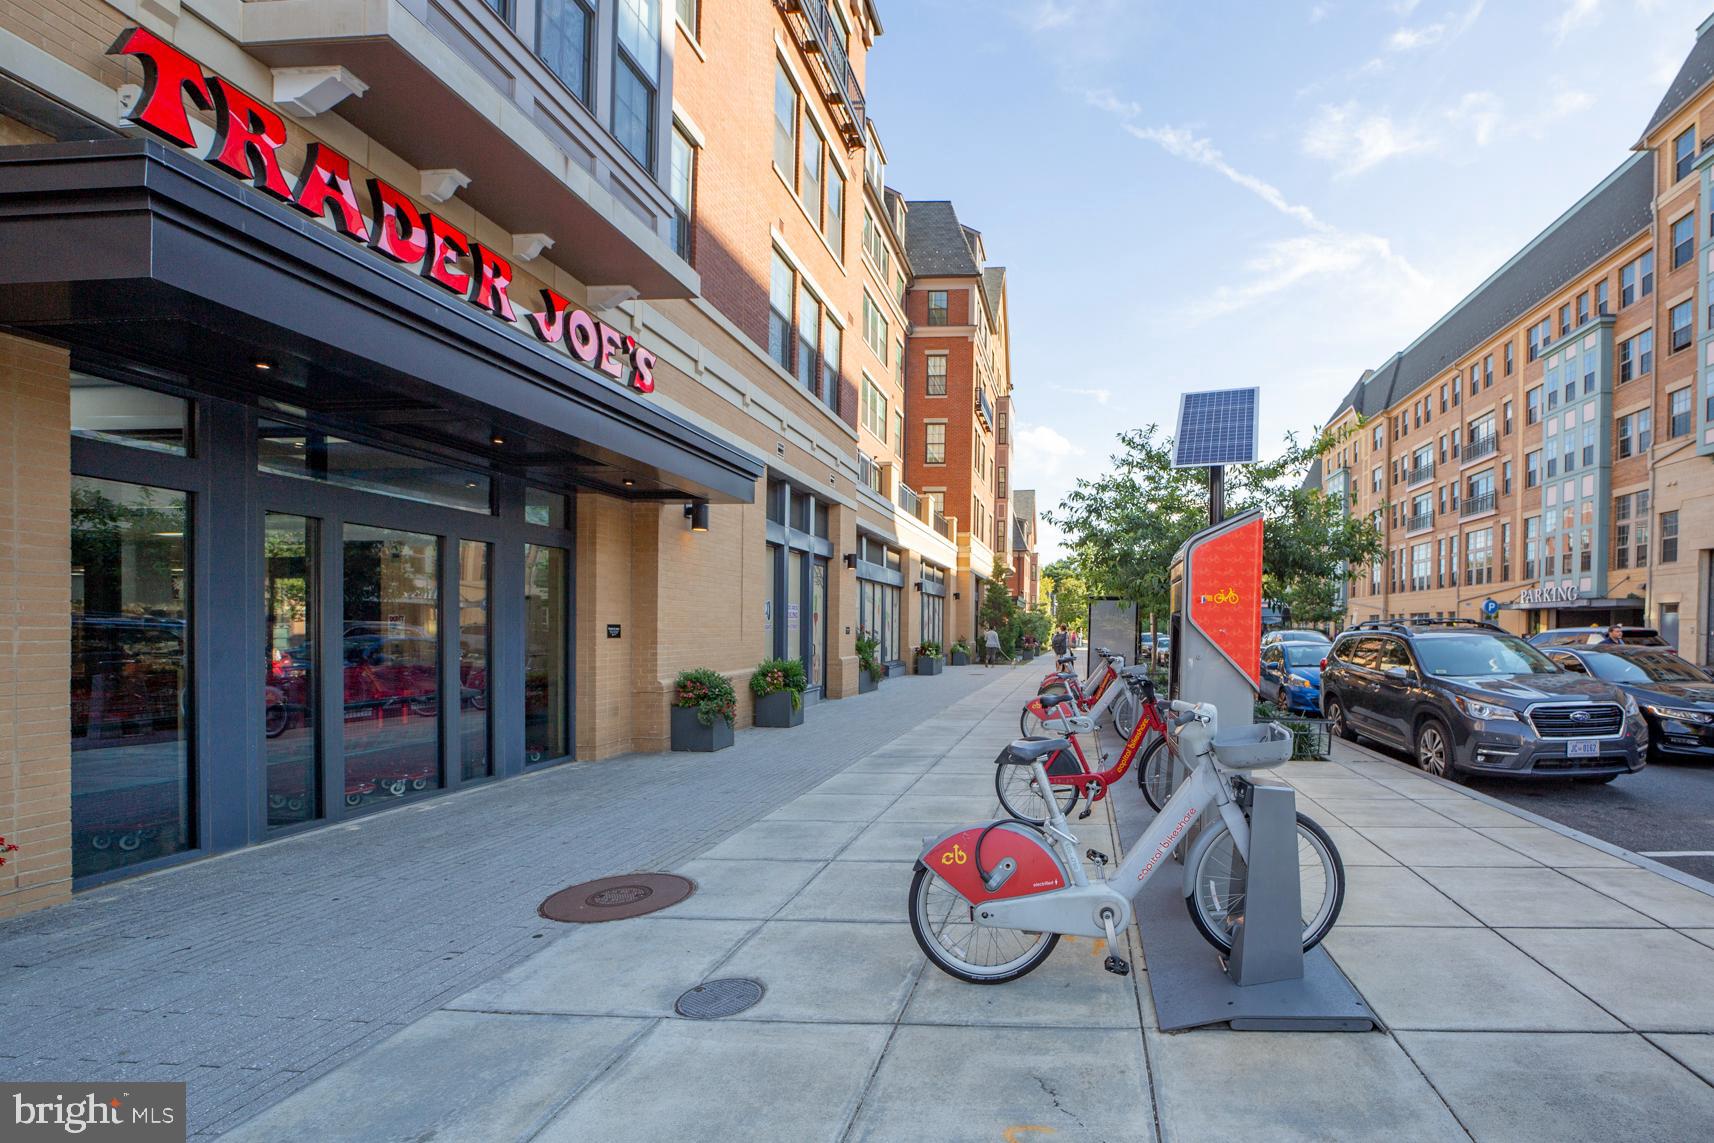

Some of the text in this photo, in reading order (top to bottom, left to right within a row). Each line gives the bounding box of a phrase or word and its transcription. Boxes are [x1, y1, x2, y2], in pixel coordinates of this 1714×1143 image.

[106, 27, 657, 394] TRADER JOE'S
[1488, 602, 1496, 611] P
[1520, 586, 1578, 603] PARKING
[1117, 718, 1151, 773] capital bikeshare
[1138, 807, 1196, 881] capital bikeshare
